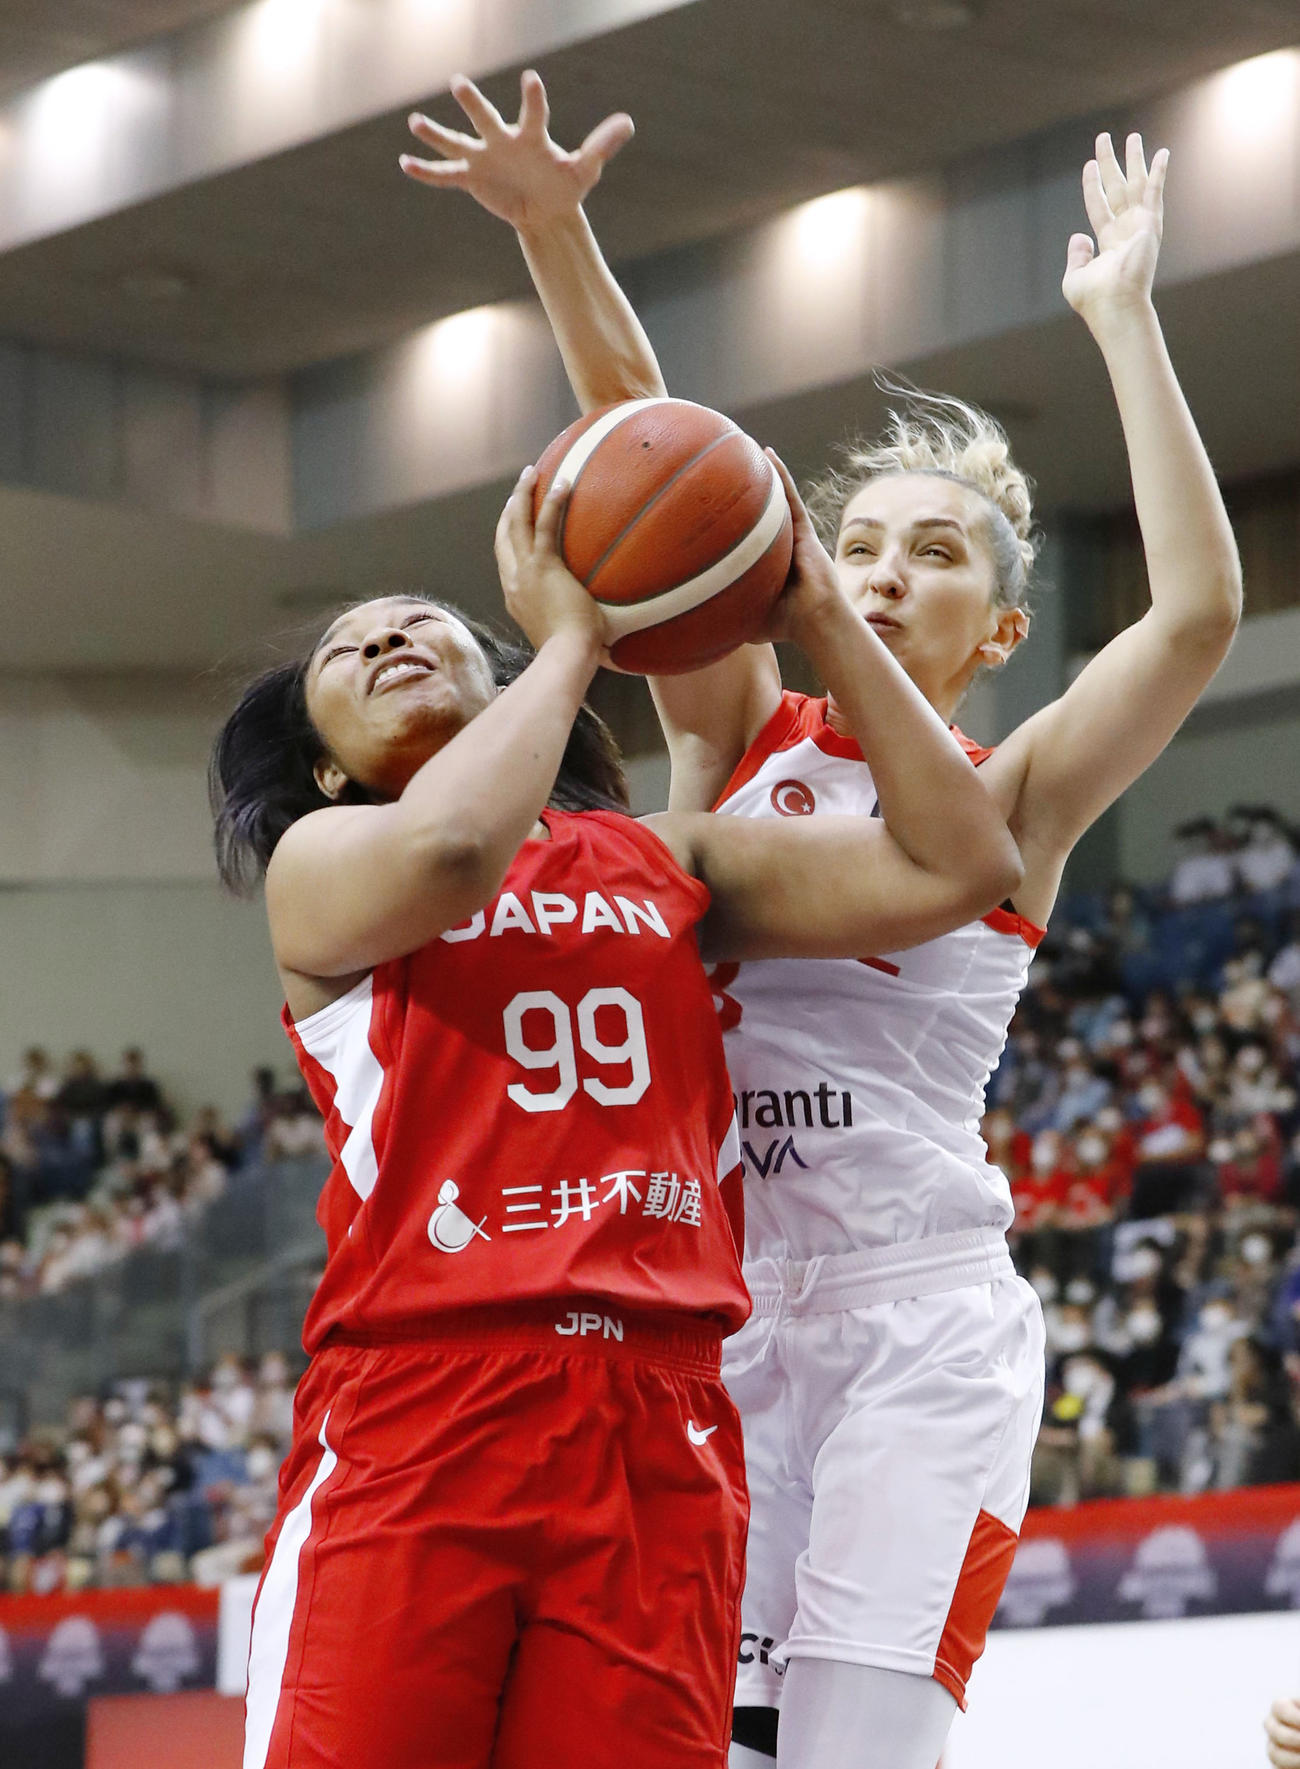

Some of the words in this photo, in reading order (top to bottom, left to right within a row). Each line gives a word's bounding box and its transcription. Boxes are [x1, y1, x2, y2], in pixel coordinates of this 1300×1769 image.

[502, 986, 652, 1113] 99
[502, 1169, 702, 1233] 三井不動産
[554, 1311, 624, 1342] JPN
